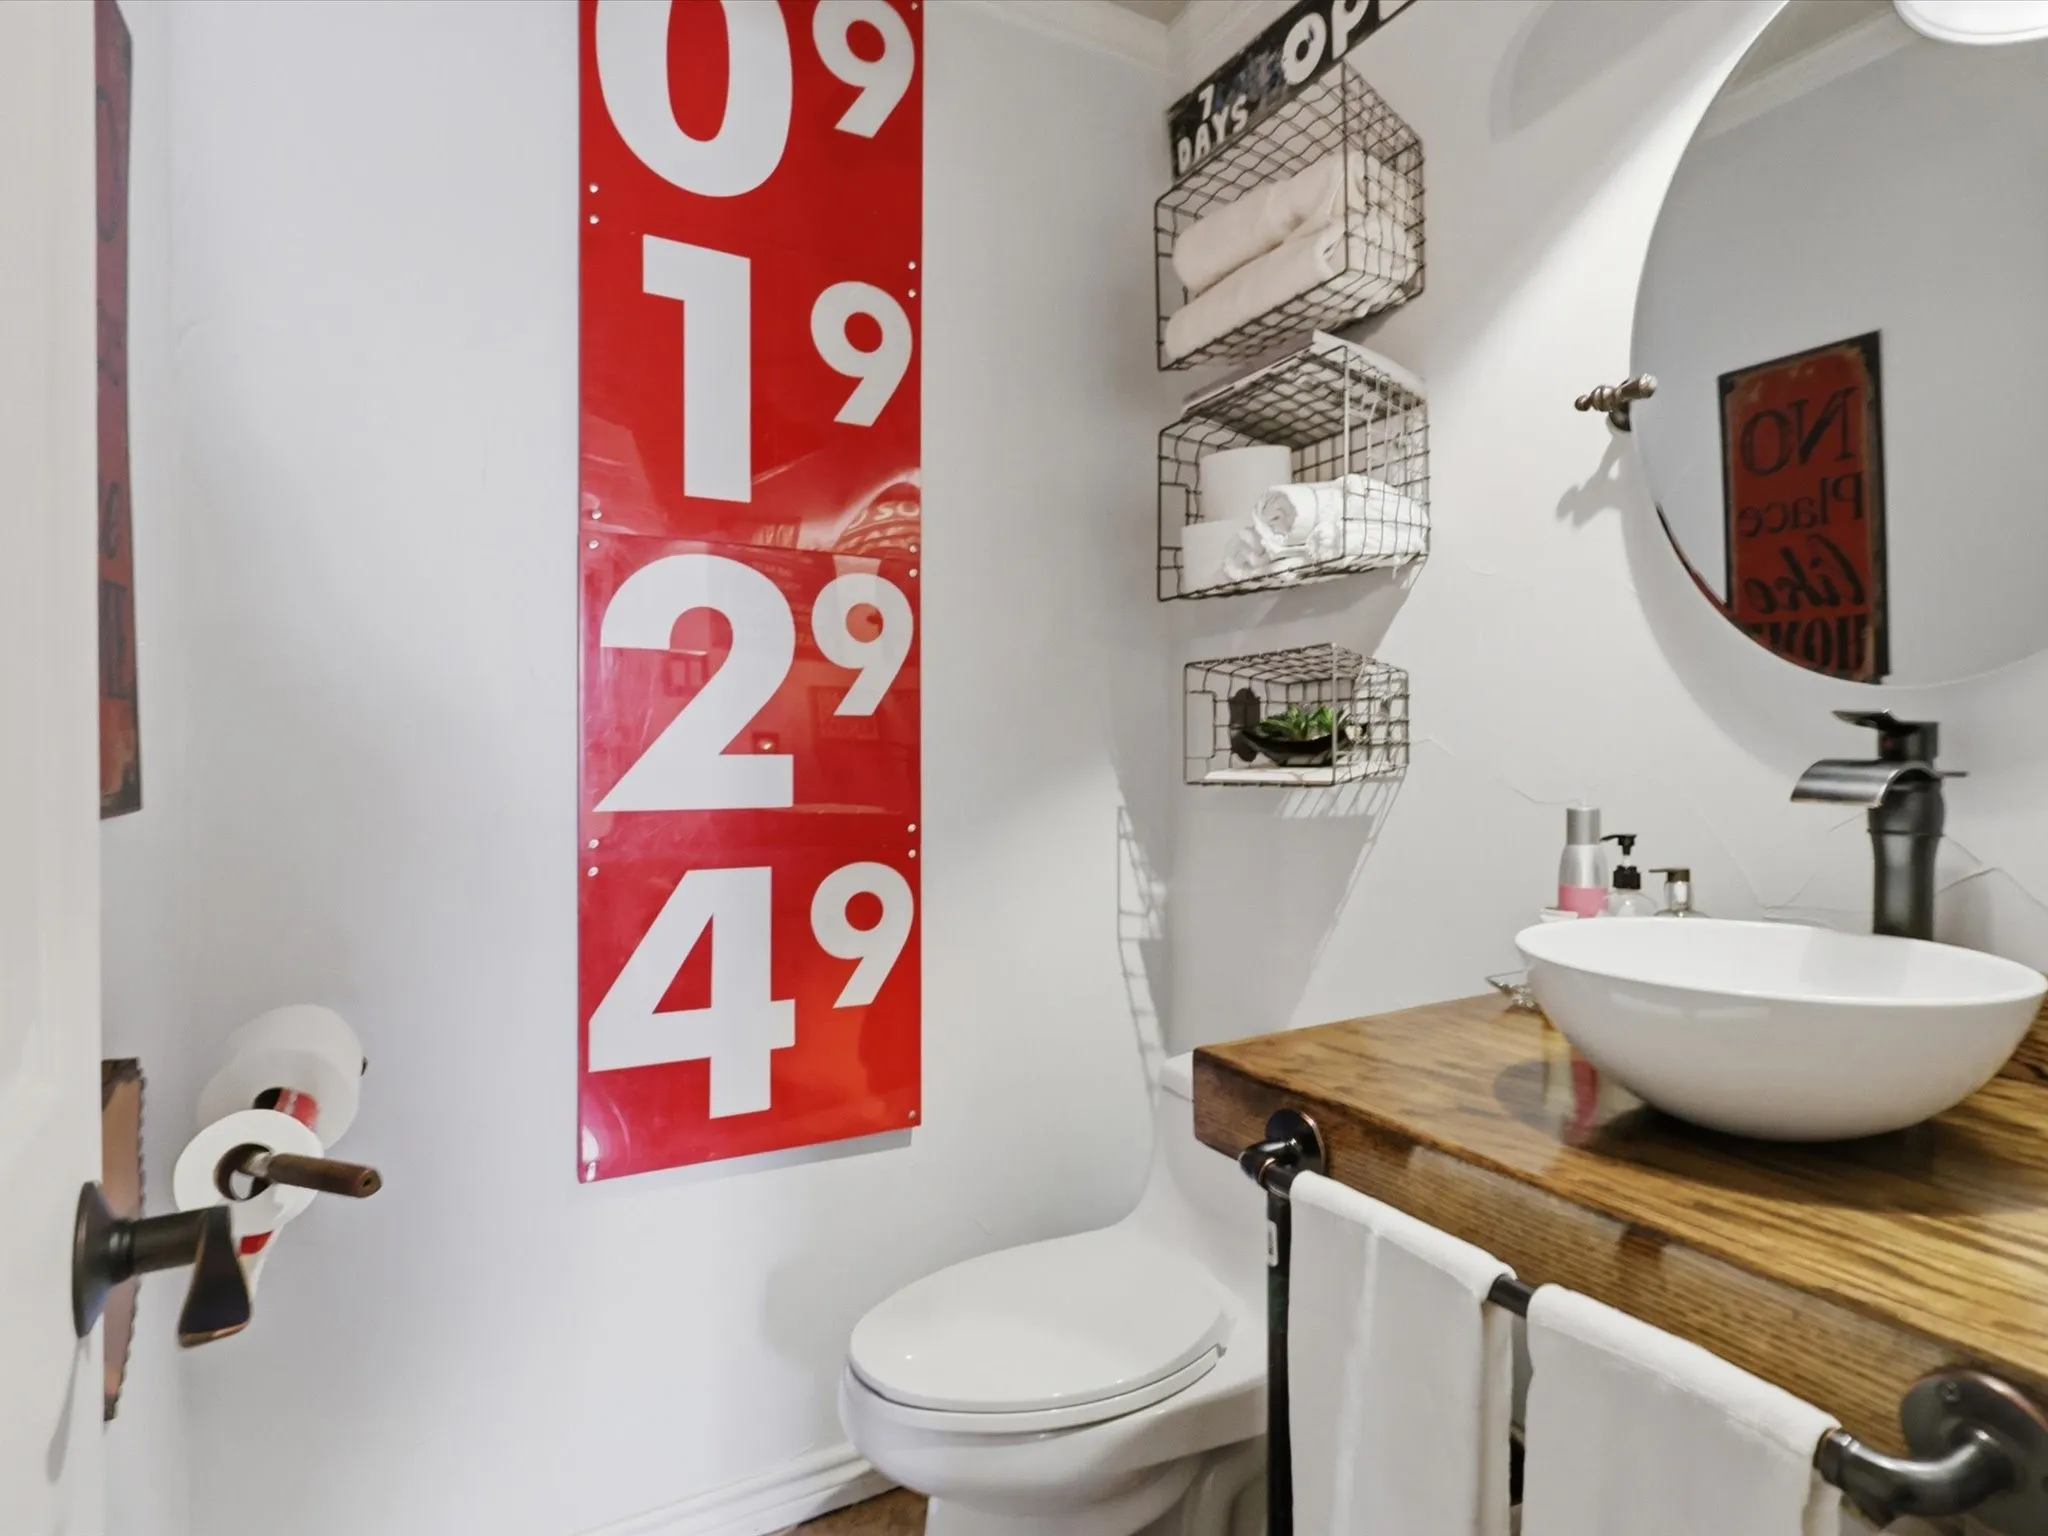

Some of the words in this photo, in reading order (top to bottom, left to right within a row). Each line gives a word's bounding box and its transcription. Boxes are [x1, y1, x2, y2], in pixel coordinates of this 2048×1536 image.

[1282, 0, 1410, 86] OP
[1176, 94, 1250, 177] DAYS
[1198, 84, 1216, 122] 7
